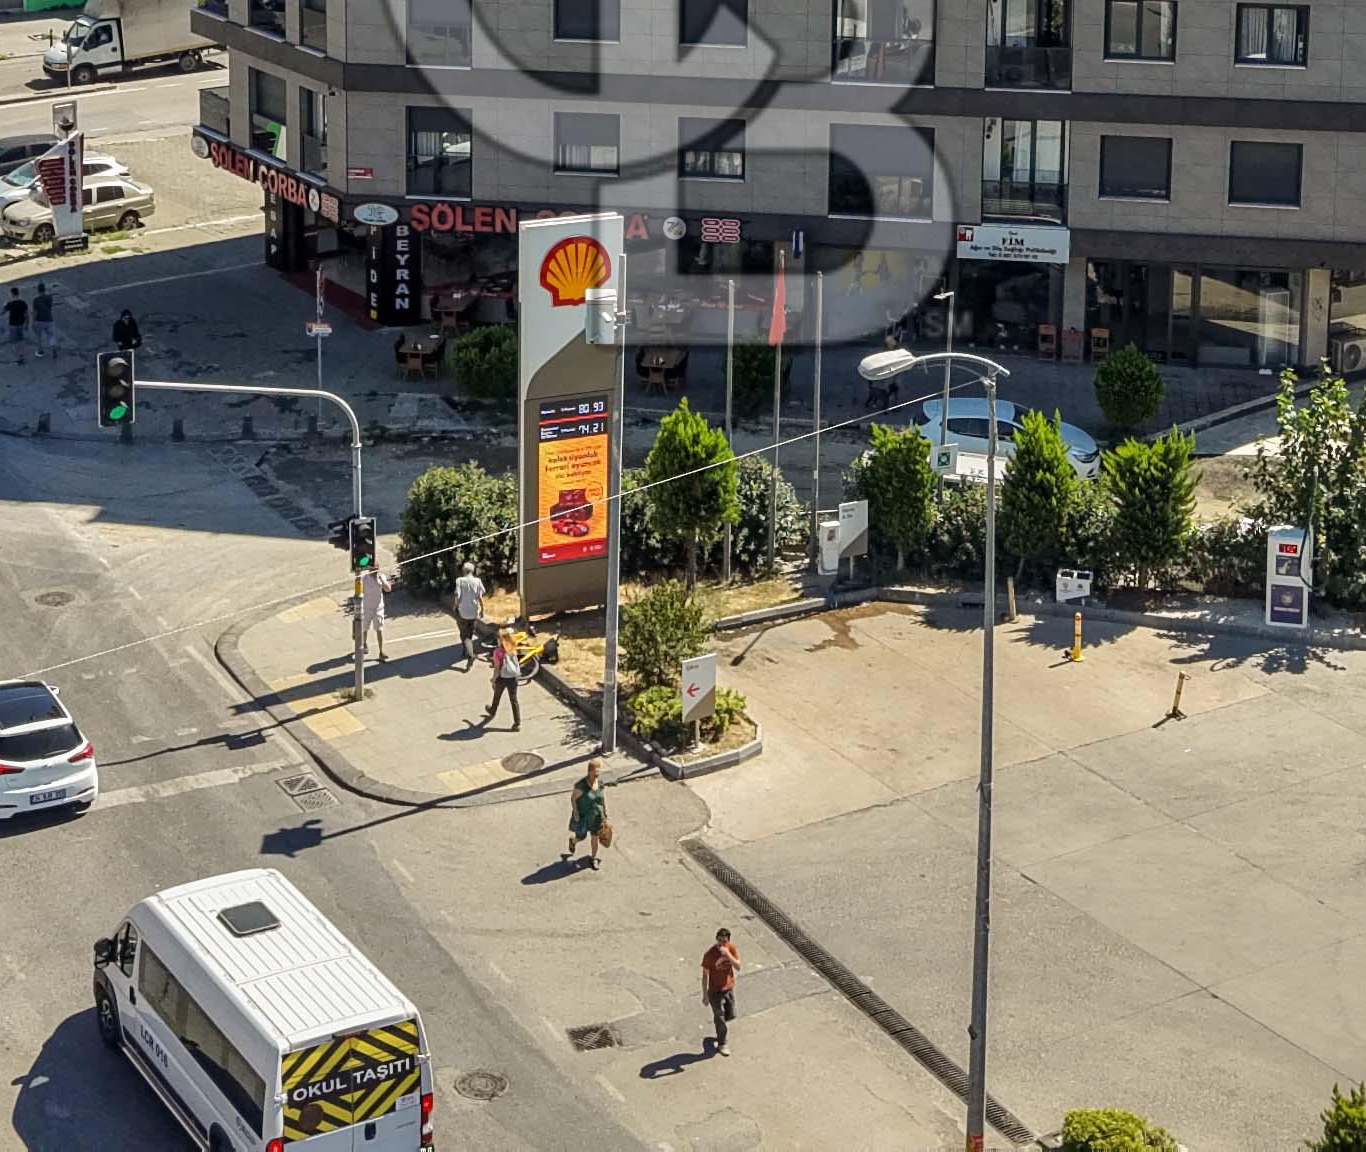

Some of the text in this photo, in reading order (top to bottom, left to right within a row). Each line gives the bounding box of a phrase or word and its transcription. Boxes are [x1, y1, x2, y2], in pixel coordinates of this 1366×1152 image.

[395, 225, 410, 310] BEYRAN
[292, 1057, 411, 1102] OKUL TAŞITI
